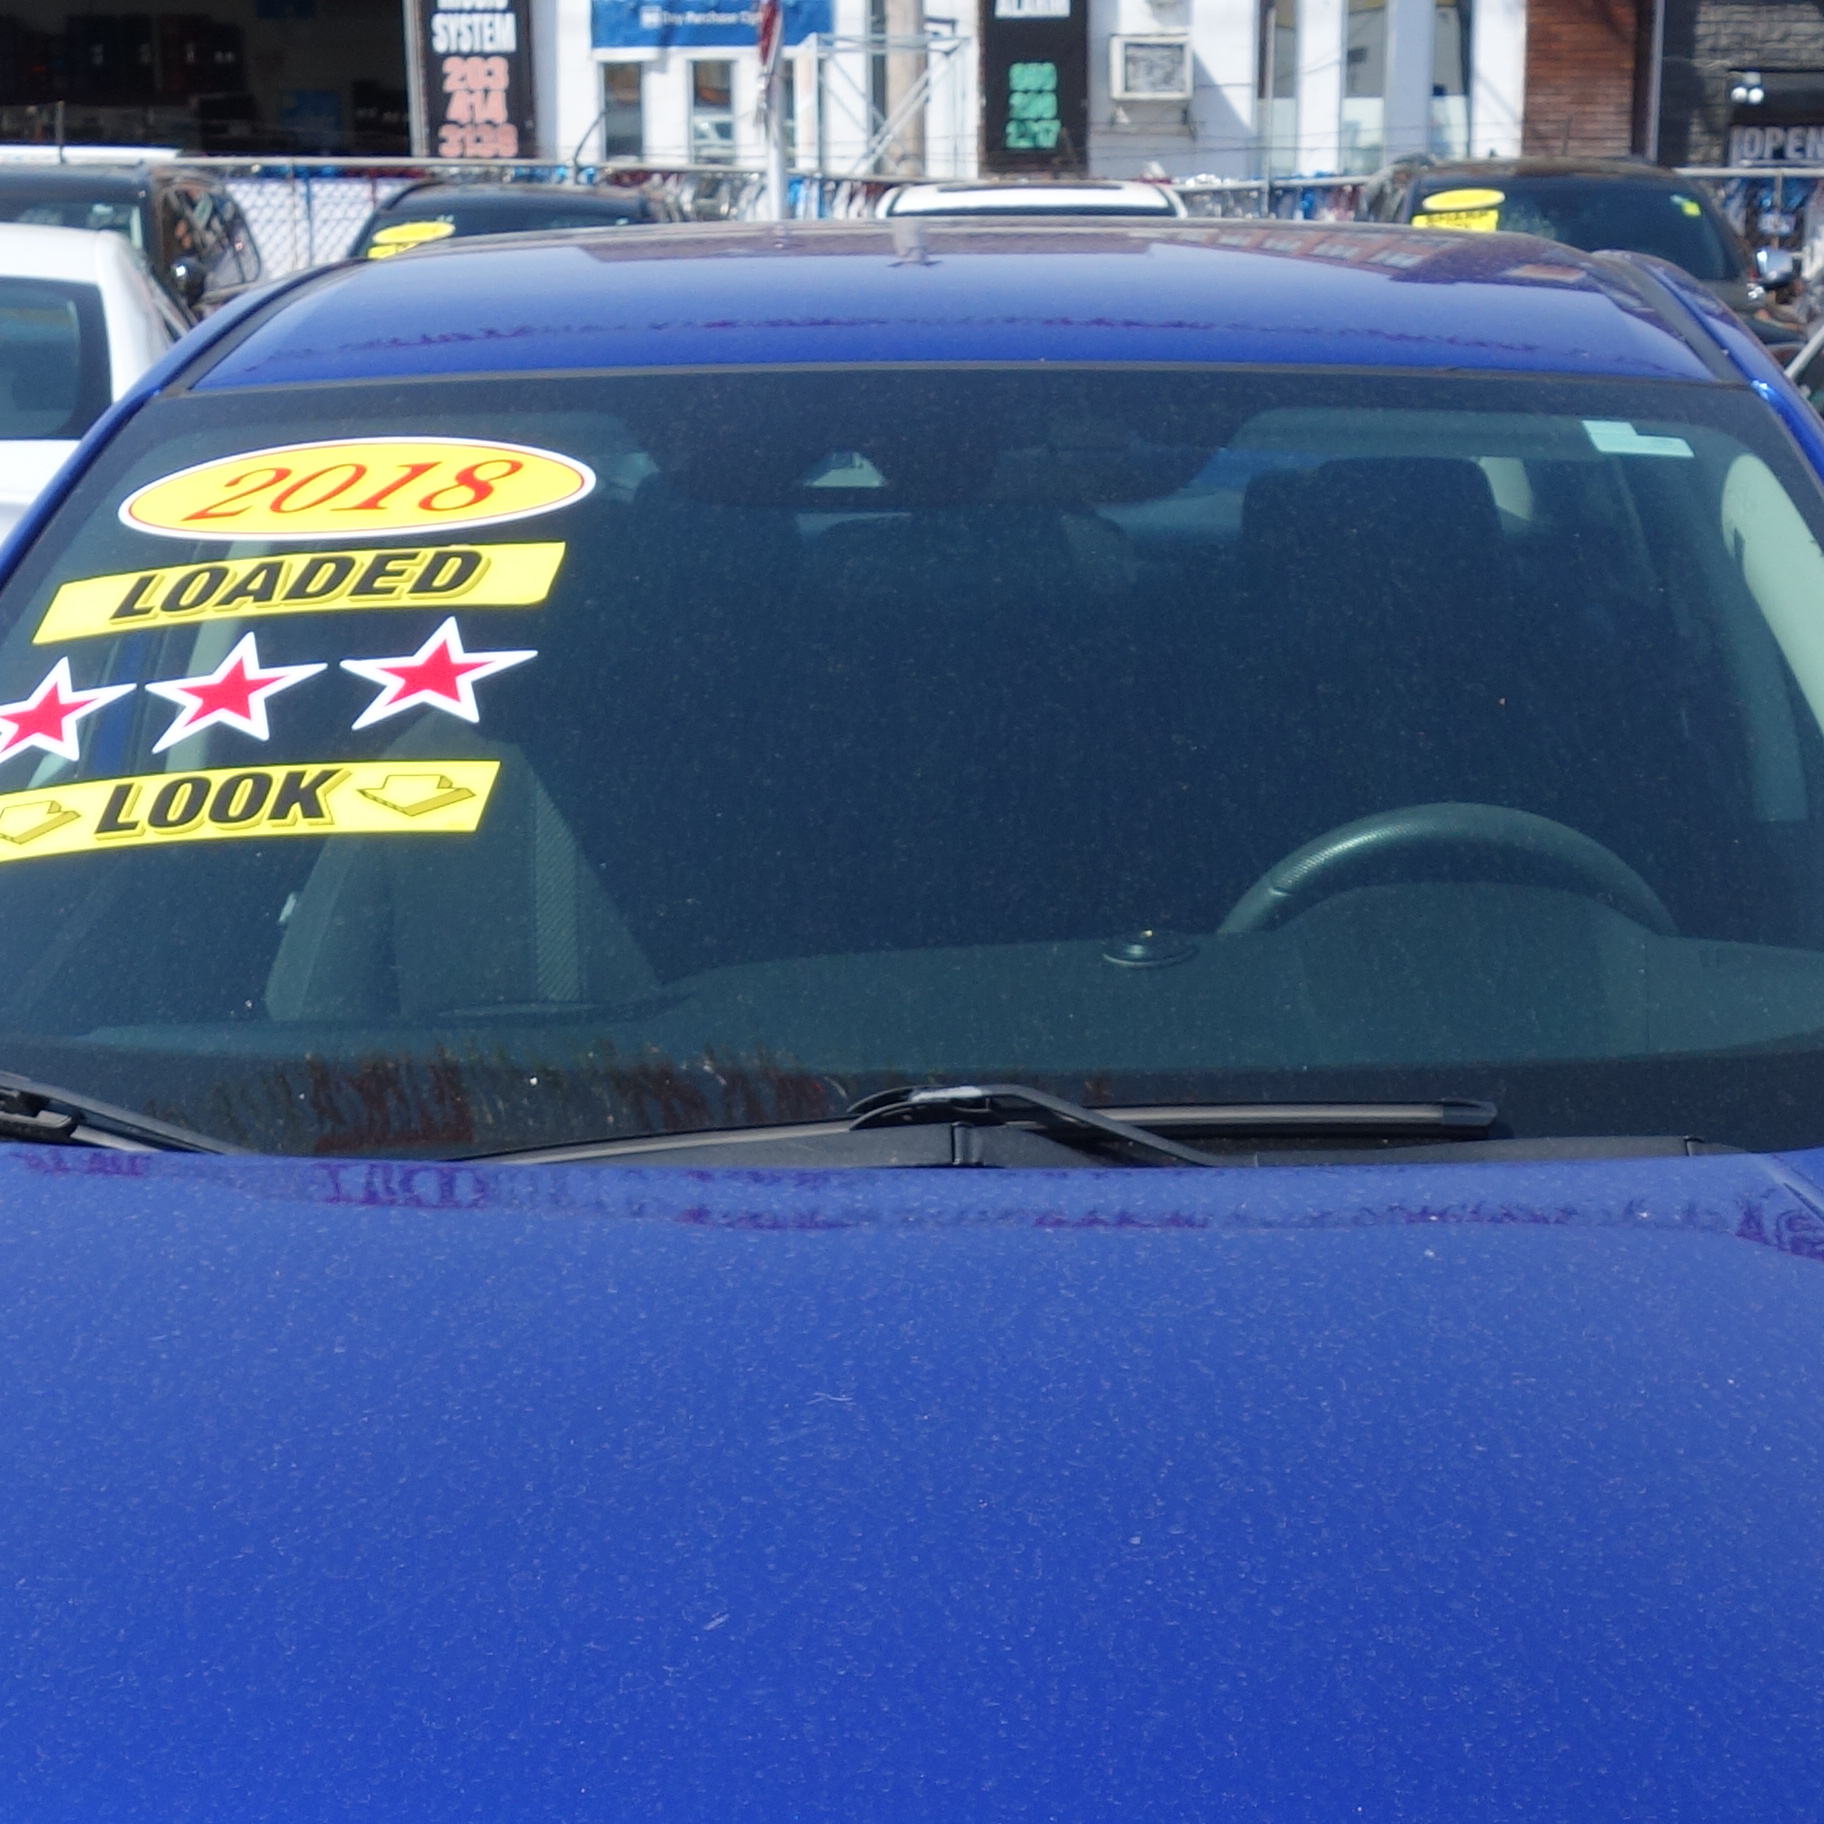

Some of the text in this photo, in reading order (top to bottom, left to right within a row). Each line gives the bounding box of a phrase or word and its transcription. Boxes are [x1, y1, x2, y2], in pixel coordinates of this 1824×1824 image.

[431, 12, 517, 54] SYSTEM
[179, 459, 525, 522] 2018
[109, 549, 492, 624] LOADED
[94, 767, 351, 841] LOOK
